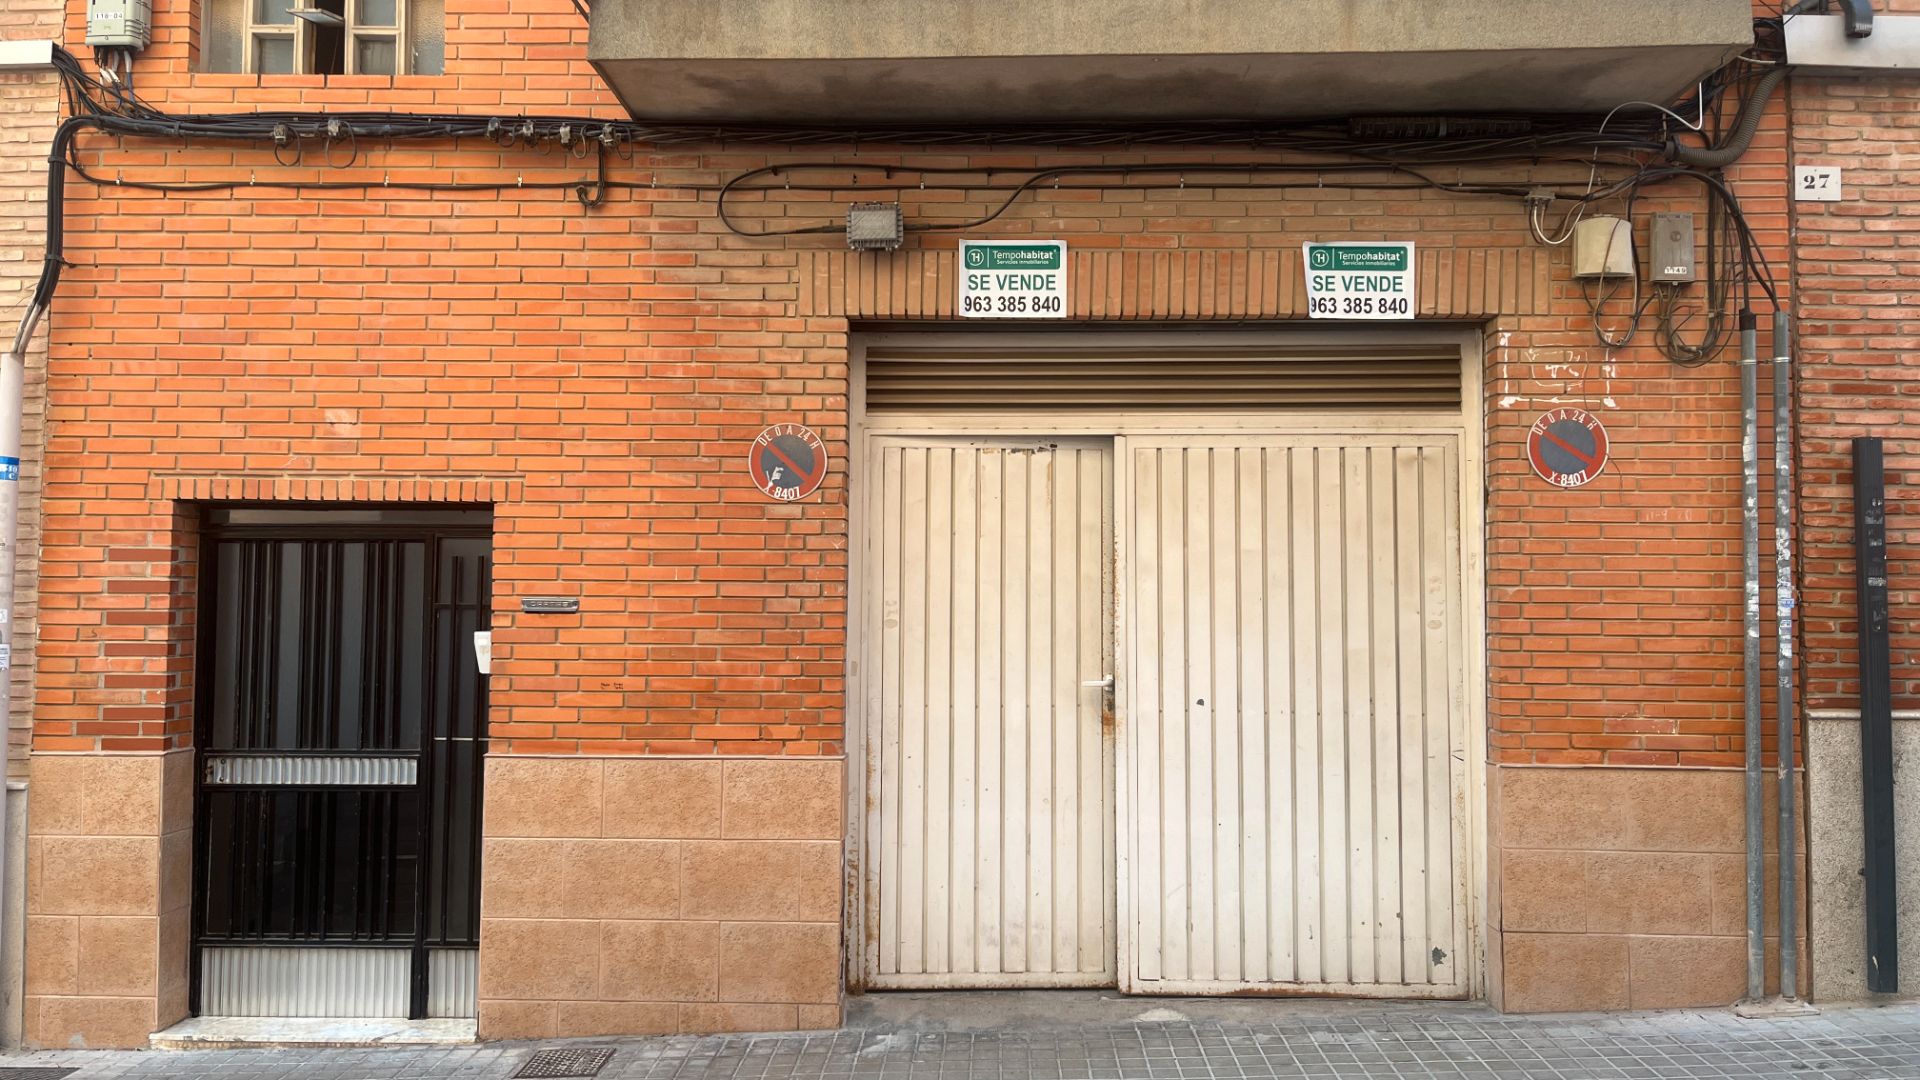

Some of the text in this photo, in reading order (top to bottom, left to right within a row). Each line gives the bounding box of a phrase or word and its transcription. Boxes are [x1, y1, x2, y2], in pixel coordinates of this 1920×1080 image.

[1803, 174, 1830, 189] 27
[992, 250, 1054, 260] Tempohabitat
[1338, 251, 1400, 262] Tempohabitat
[968, 274, 1056, 291] SE VENDE
[1312, 275, 1404, 292] SE VENDE
[964, 296, 1060, 312] 963 385 840
[1311, 297, 1408, 314] 963 385 840
[1532, 420, 1548, 436] DE
[1560, 409, 1567, 420] A
[1572, 410, 1586, 423] 24
[757, 432, 773, 446] DE
[786, 425, 793, 435] A
[797, 427, 811, 442] 24
[809, 439, 820, 449] H
